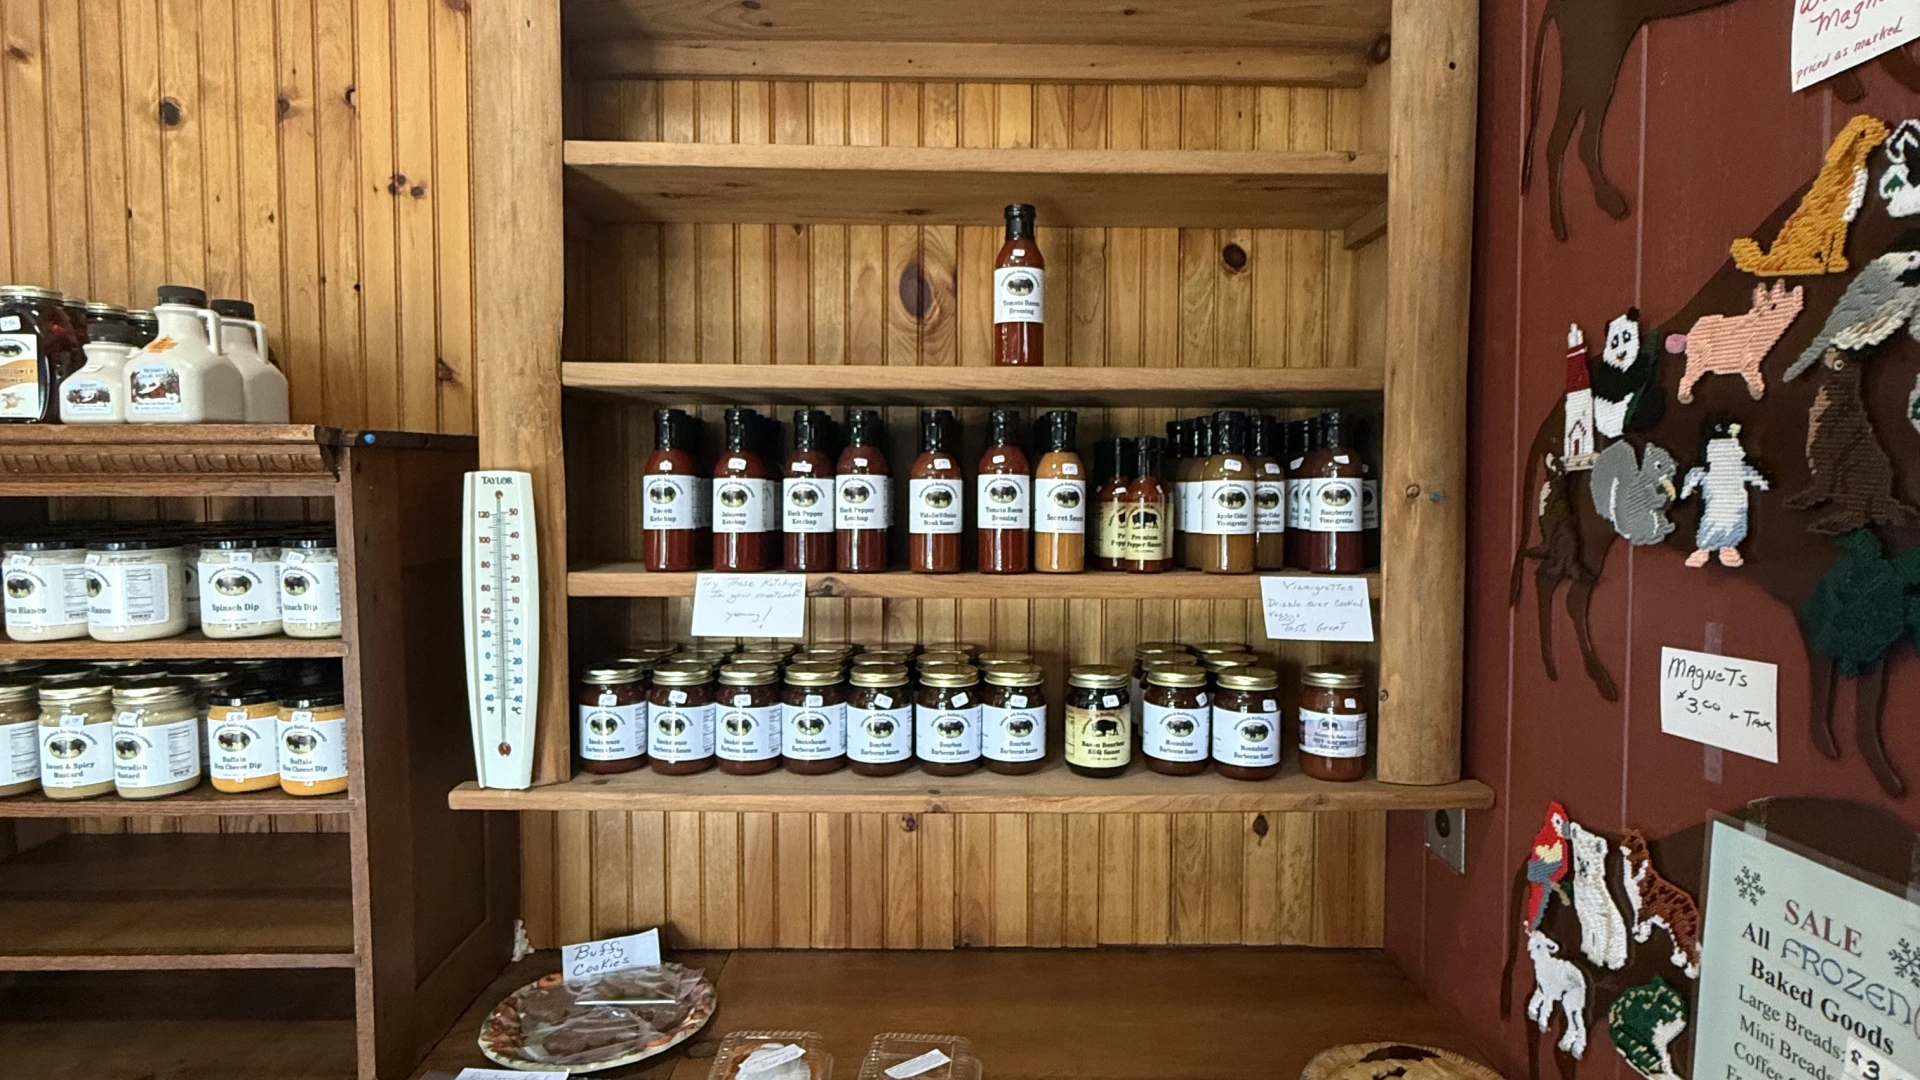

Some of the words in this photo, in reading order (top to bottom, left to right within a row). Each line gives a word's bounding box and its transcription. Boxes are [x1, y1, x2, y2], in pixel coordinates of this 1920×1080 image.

[1834, 47, 1848, 61] as
[1853, 16, 1904, 52] marked
[481, 476, 513, 485] TAYLOR
[478, 510, 490, 519] 120
[509, 508, 518, 516] 50
[509, 531, 520, 539] 40
[479, 536, 491, 544] 100
[480, 561, 491, 569] 80
[511, 596, 520, 604] 10
[1268, 598, 1301, 608] Drizzle
[212, 604, 242, 612] Spinach
[244, 603, 260, 612] Dip
[303, 603, 318, 611] Dip
[481, 607, 492, 615] 40
[513, 617, 520, 625] 0
[481, 630, 492, 638] 20
[512, 657, 523, 665] 20
[484, 694, 494, 702] 40
[73, 761, 95, 770] Spicy
[248, 762, 263, 770] Dip
[315, 765, 328, 773] Dip
[1784, 899, 1863, 958] SALE
[574, 940, 624, 961] Buffy
[572, 956, 630, 976] Cookies
[1741, 922, 1770, 950] All
[1781, 938, 1912, 1025] FROZEN
[1750, 956, 1813, 1009] Baked
[1821, 998, 1894, 1055] Goods
[1738, 984, 1781, 1022] Large
[1785, 1011, 1846, 1063] Breads:
[1740, 1015, 1774, 1050] Mini
